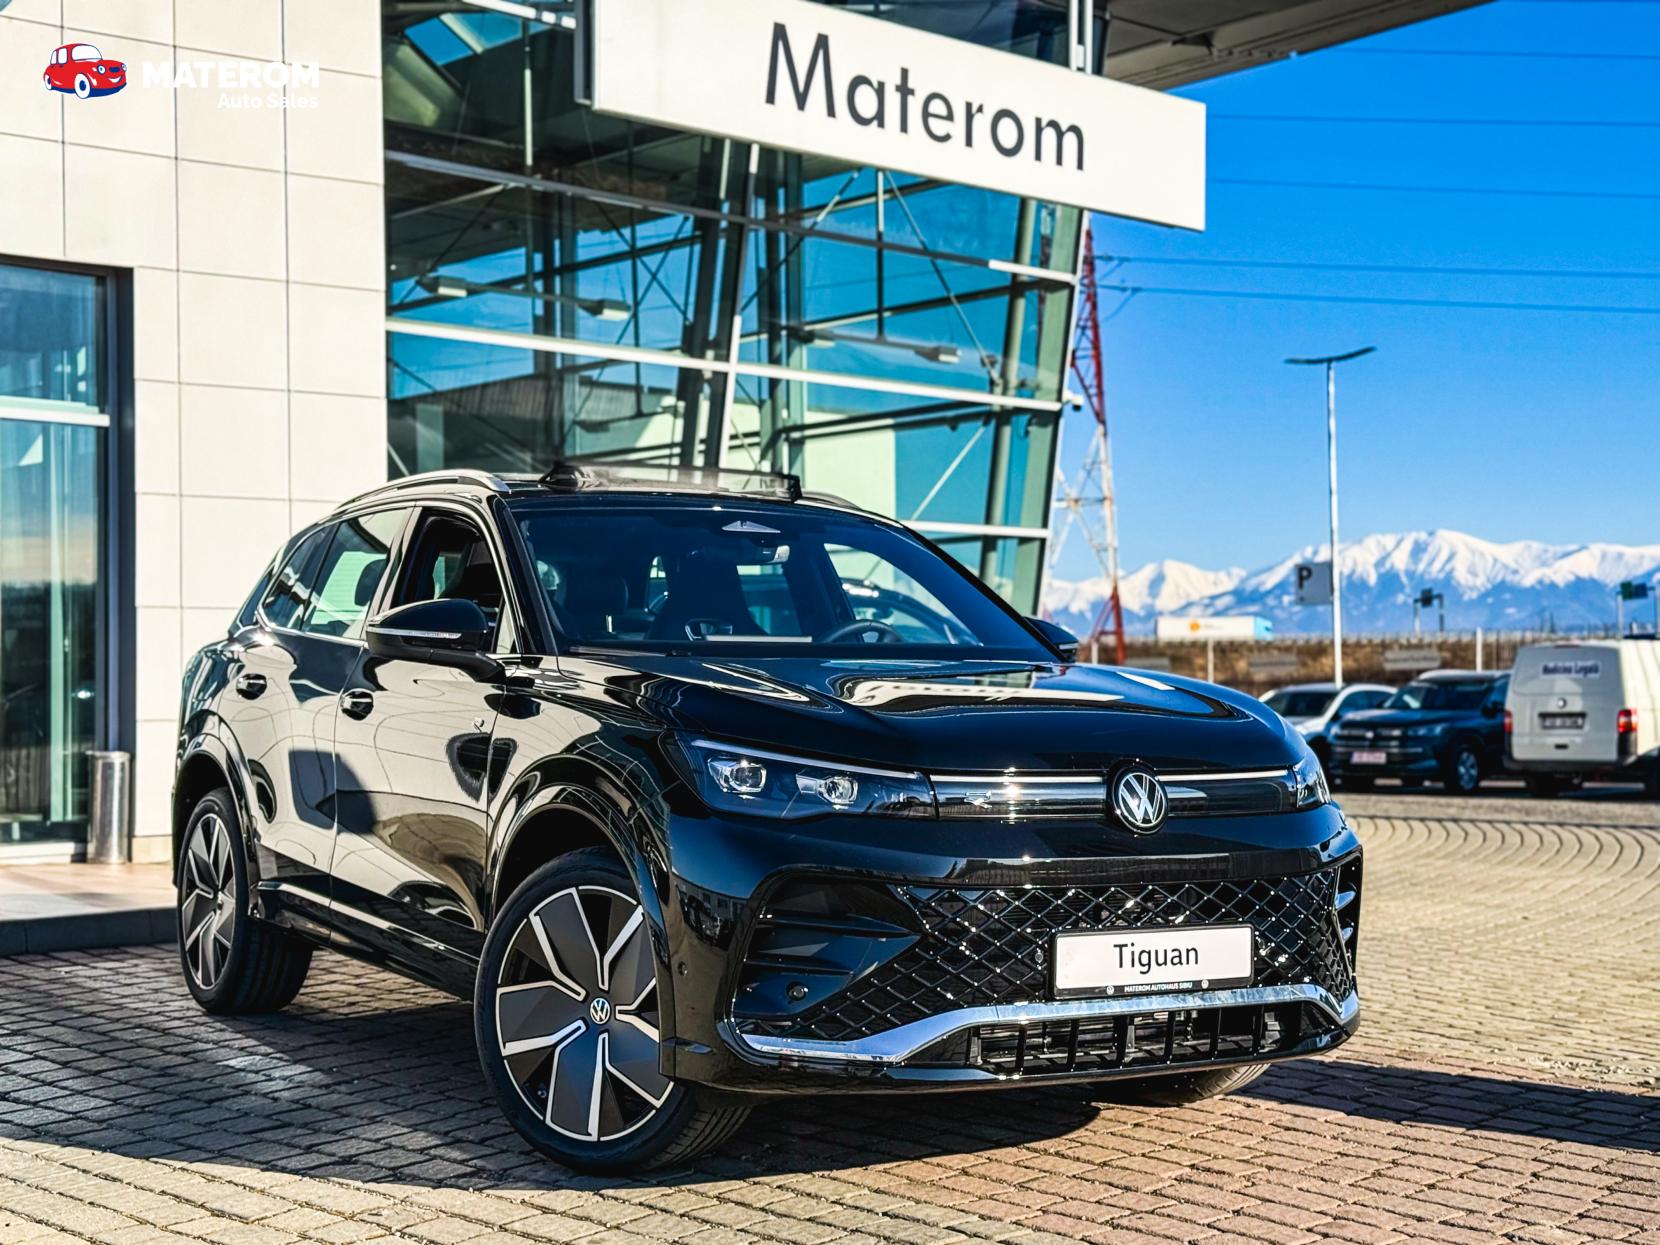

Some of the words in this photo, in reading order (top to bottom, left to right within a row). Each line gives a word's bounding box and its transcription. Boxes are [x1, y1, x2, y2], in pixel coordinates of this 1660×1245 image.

[765, 22, 1085, 171] Materom
[1298, 565, 1312, 590] P
[1113, 942, 1199, 975] Tiguan
[1124, 985, 1151, 993] MATEROM
[1151, 983, 1178, 991] AUTOHAUS
